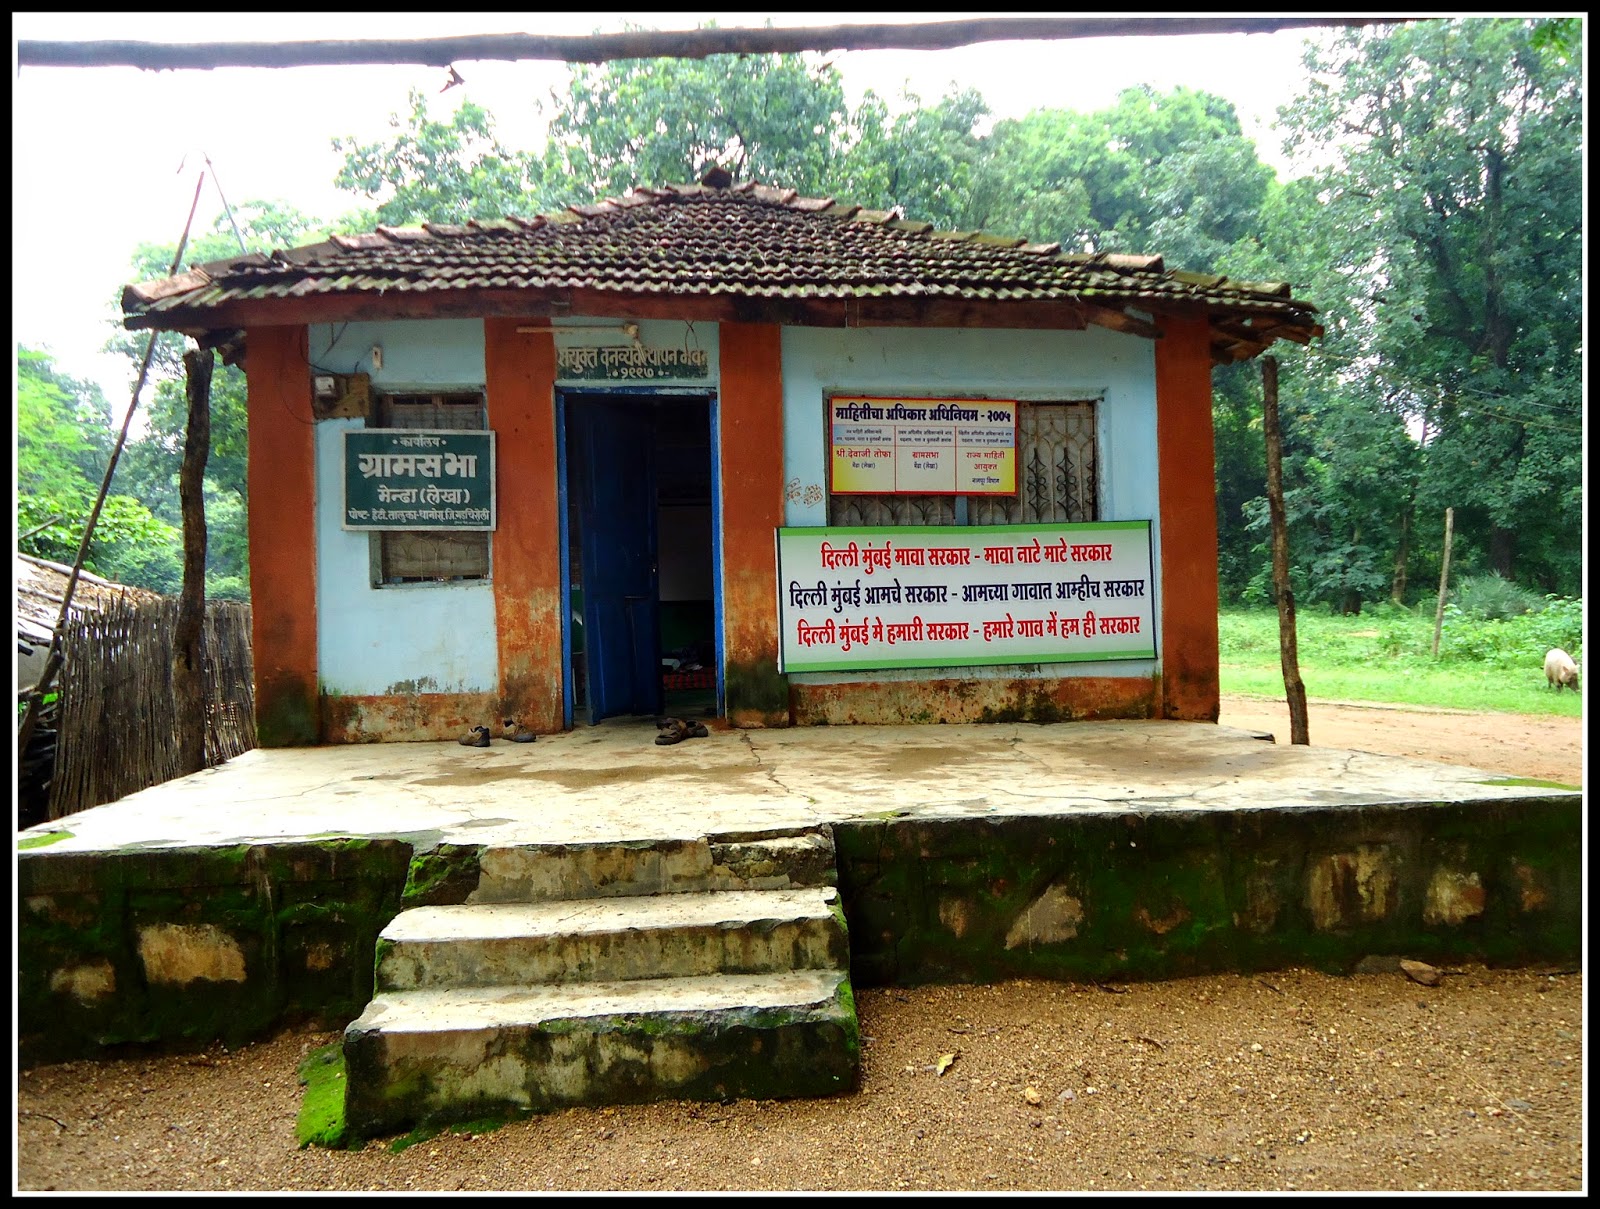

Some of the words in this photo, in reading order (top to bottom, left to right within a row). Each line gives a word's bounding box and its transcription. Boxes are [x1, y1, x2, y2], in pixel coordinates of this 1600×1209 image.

[835, 402, 884, 422] माहितीचा
[886, 403, 927, 421] अधिकार
[929, 403, 979, 422] अधिनियम
[987, 410, 1011, 423] २००५
[400, 434, 441, 448] कार्यालय
[358, 452, 478, 479] ग्रामसभा
[419, 484, 471, 505] (लेखा)
[821, 541, 859, 570] दिल्ली
[862, 541, 891, 574] मुंबई
[895, 548, 925, 566] मावा
[928, 547, 971, 566] सरकार
[984, 546, 1014, 564] मावा
[1017, 538, 1041, 564] नाटे
[1044, 537, 1067, 563] माटे
[1070, 544, 1112, 562] सरकार
[789, 580, 828, 609] दिल्ली
[831, 579, 861, 613] मुंबई
[864, 578, 901, 605] आमचे
[904, 585, 948, 603] सरकार
[962, 583, 1008, 602] आमच्या
[1011, 582, 1052, 600] गावात
[1056, 573, 1100, 601] आम्हीच
[1103, 579, 1145, 597] सरकार
[797, 618, 835, 647] दिल्ली
[839, 617, 869, 652] मुंबई
[872, 616, 883, 642] मे
[886, 615, 923, 644] हमारी
[926, 622, 970, 640] सरकार
[983, 612, 1014, 641] हमारे
[1017, 619, 1043, 638] गाव
[1046, 611, 1057, 637] में
[1060, 617, 1080, 638] हम
[1082, 610, 1097, 638] ही
[1099, 616, 1141, 635] सरकार
